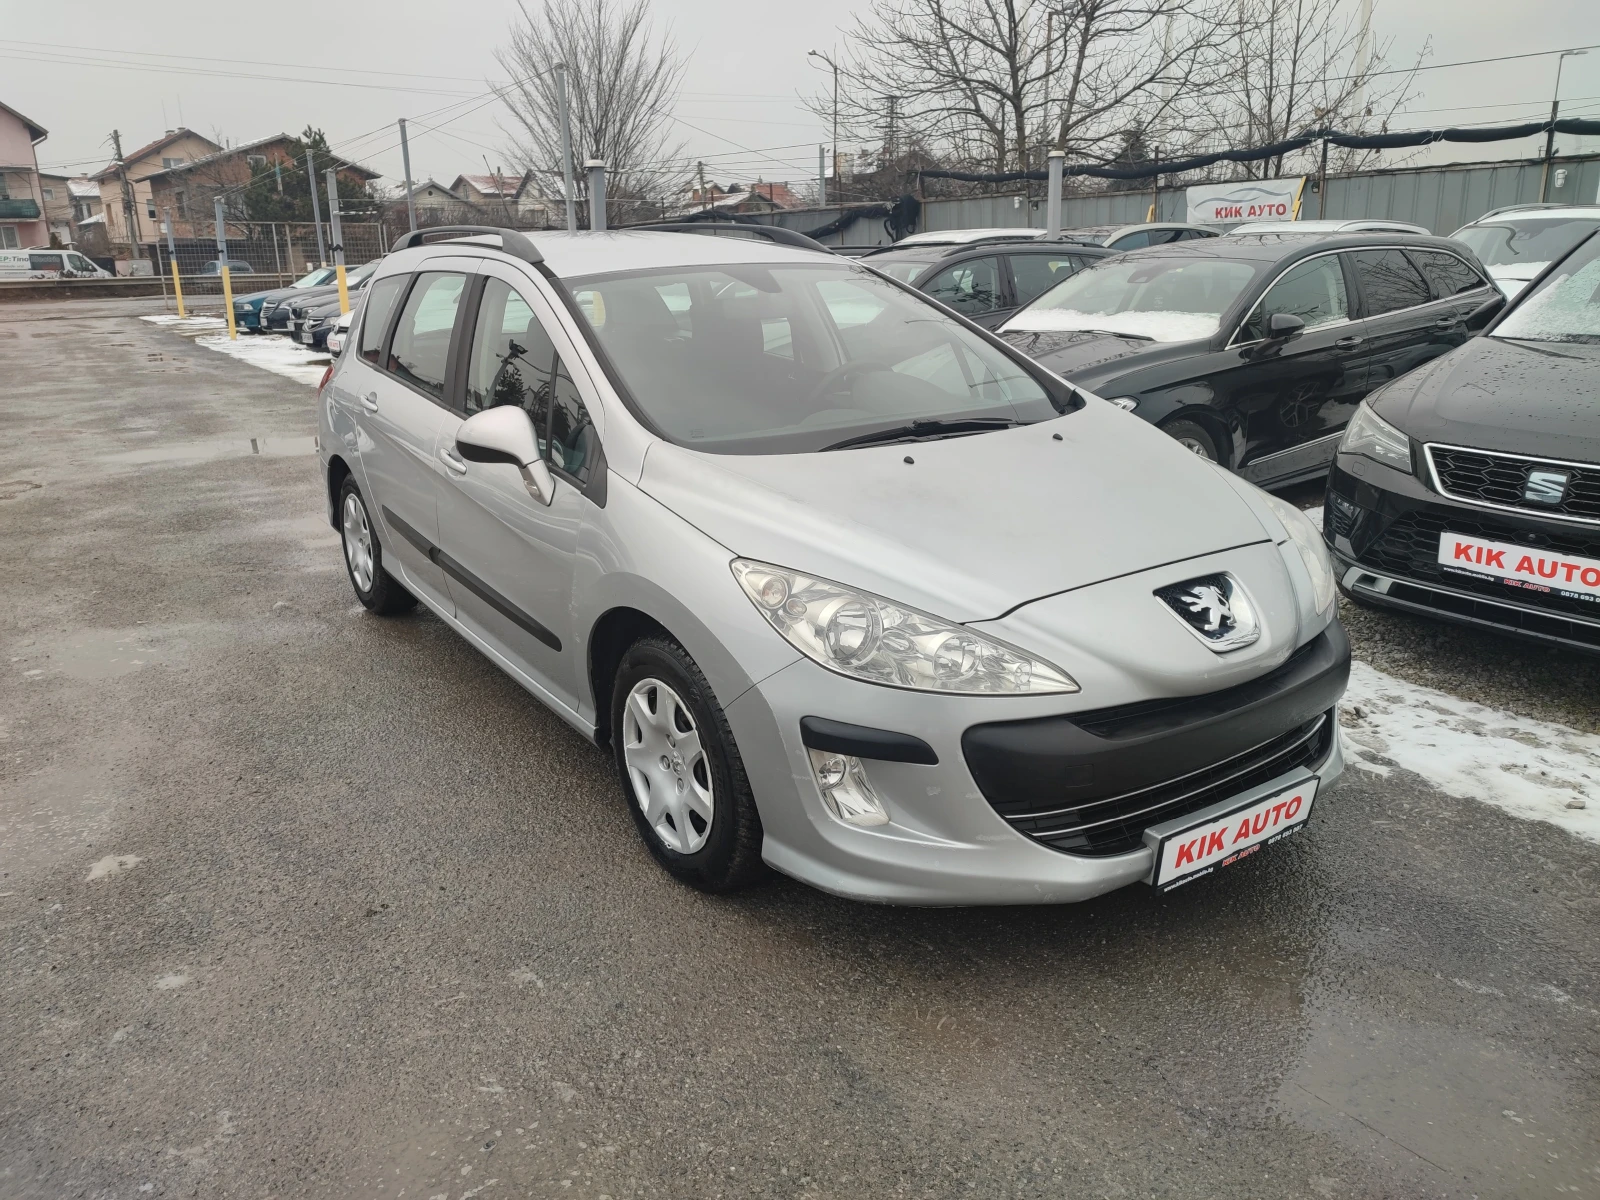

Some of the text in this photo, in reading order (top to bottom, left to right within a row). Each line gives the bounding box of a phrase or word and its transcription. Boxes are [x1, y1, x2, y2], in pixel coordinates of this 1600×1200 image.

[1215, 203, 1287, 219] КИК АУТО
[1454, 542, 1600, 587] KIK AUTO
[1503, 578, 1522, 587] KIK
[1523, 583, 1550, 593] AUTO
[1174, 795, 1303, 869] KIK AUTO
[1222, 853, 1239, 867] KIK
[1237, 843, 1260, 860] AUTO
